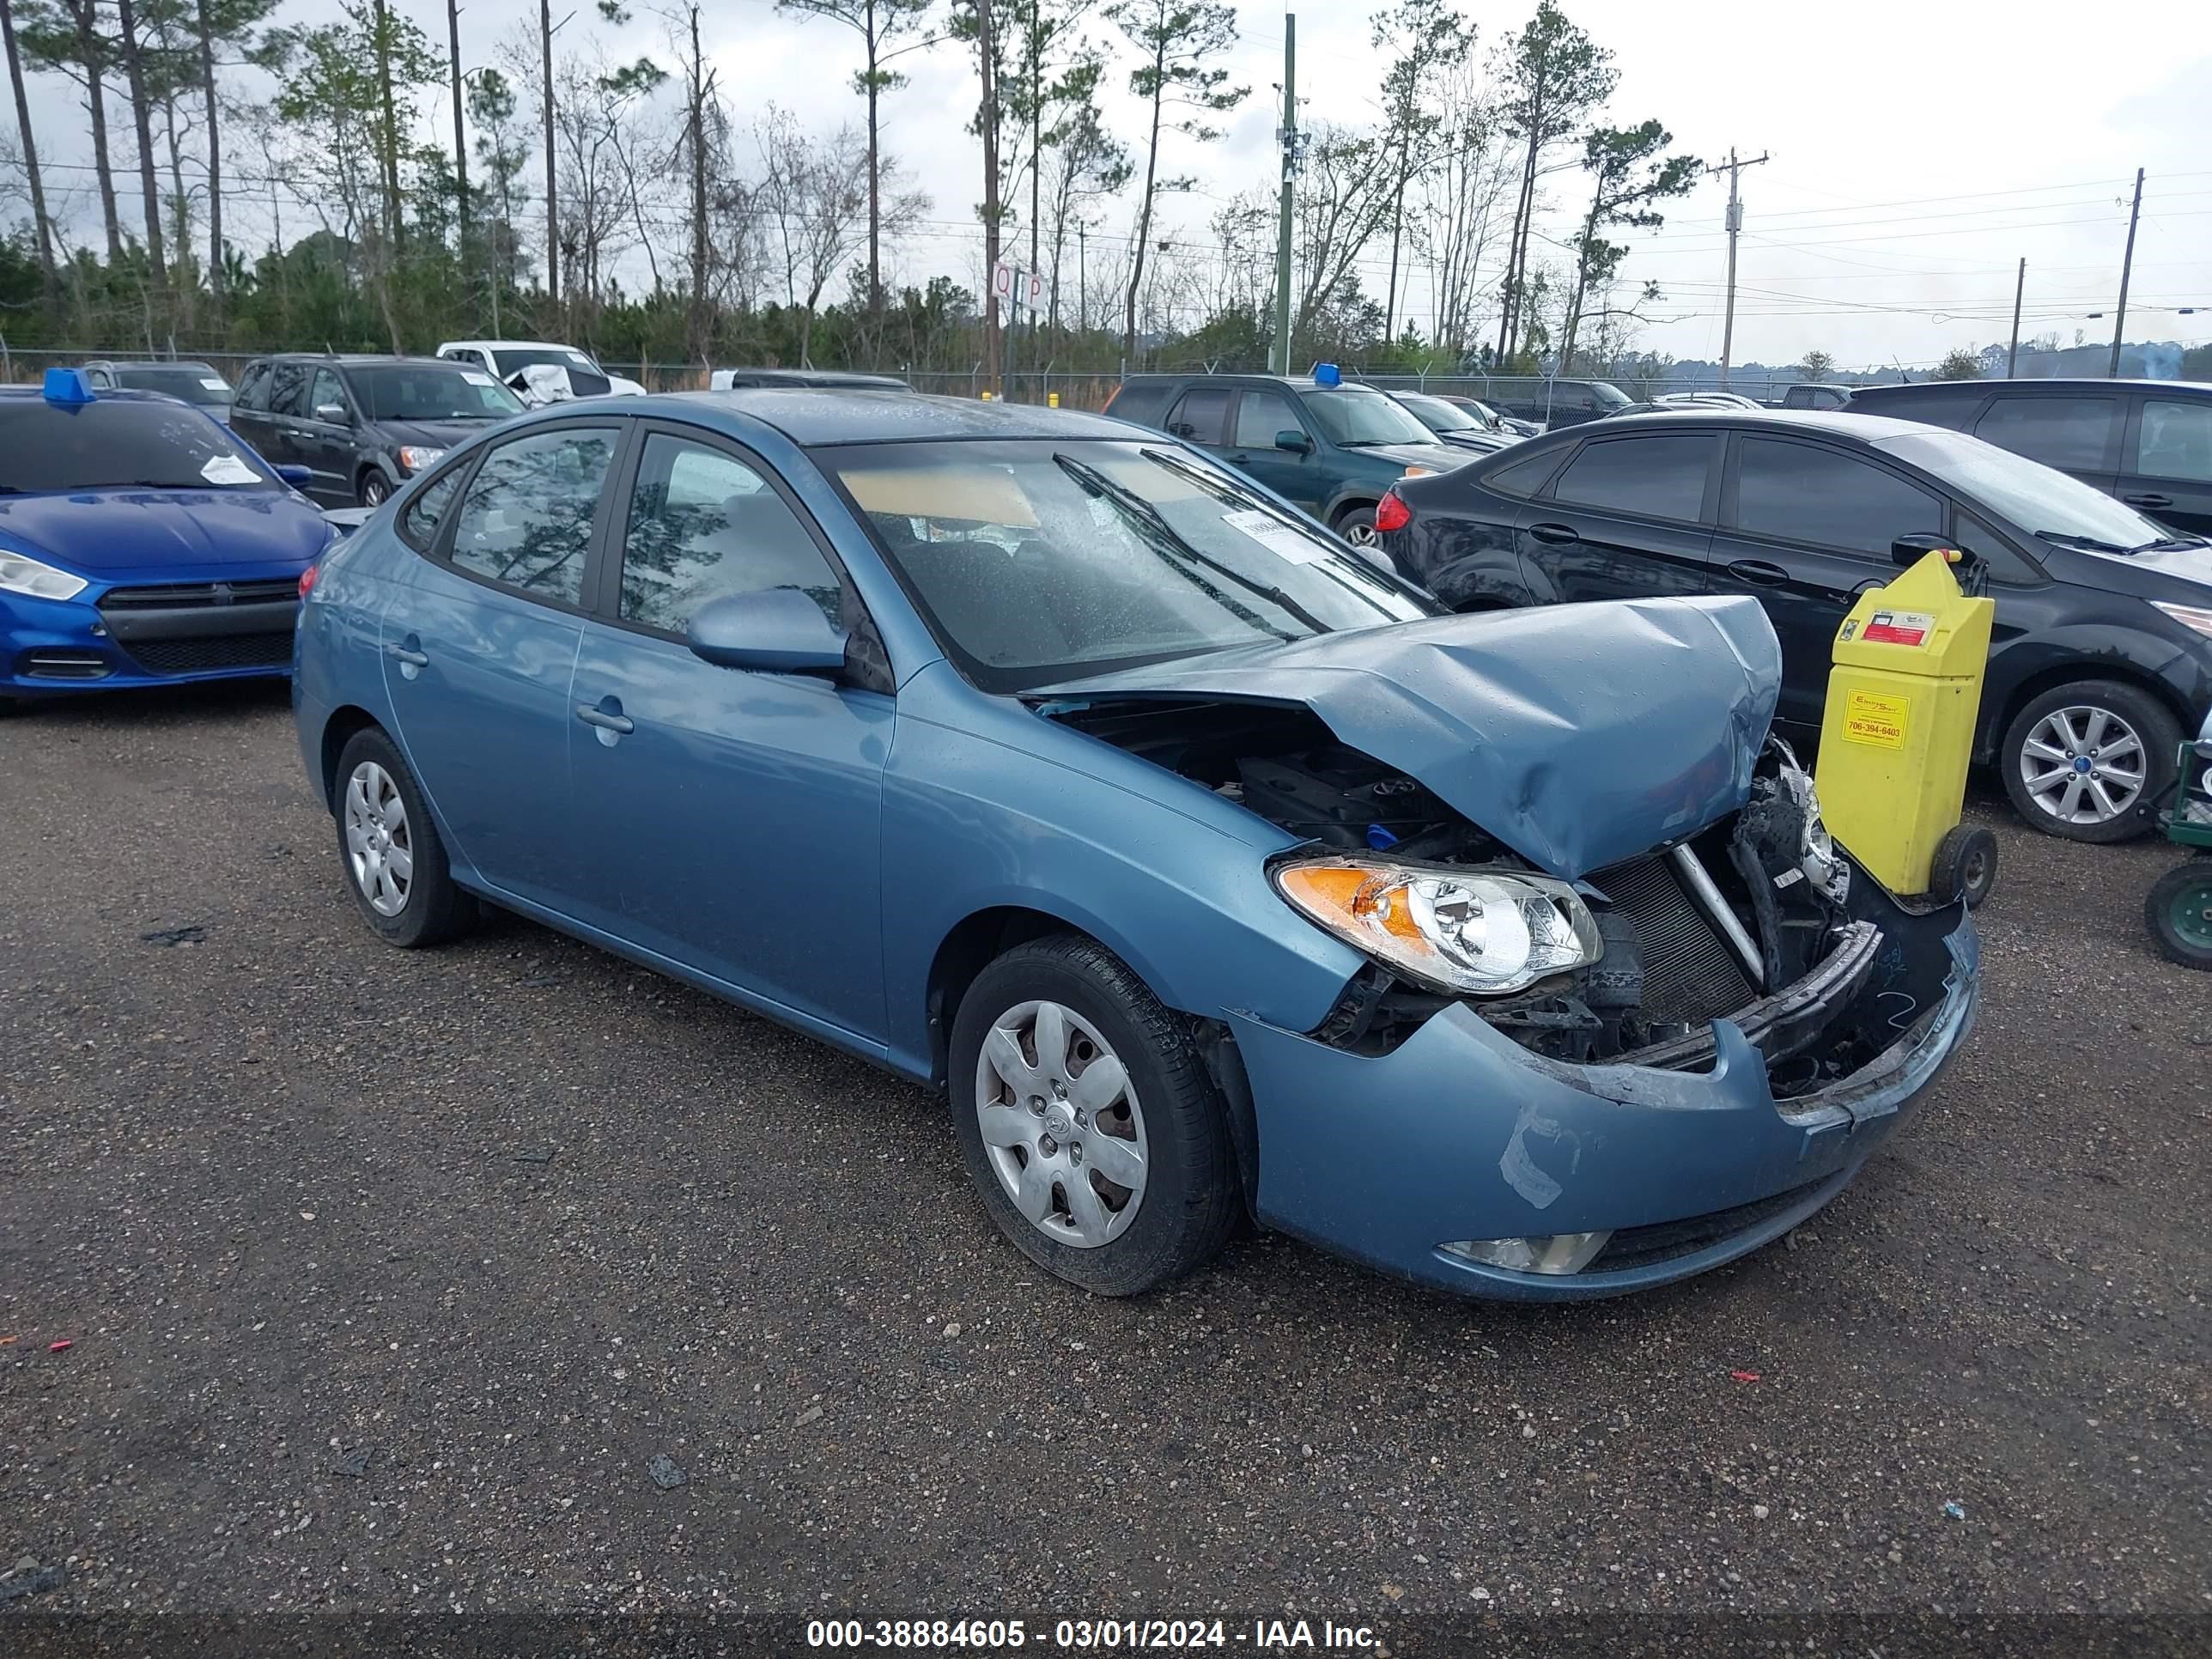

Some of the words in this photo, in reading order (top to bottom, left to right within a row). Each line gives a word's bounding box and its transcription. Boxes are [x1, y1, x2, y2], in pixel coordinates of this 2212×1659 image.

[997, 267, 1010, 298] Q
[1030, 279, 1041, 305] P
[1849, 721, 1900, 737] 706-394-6403
